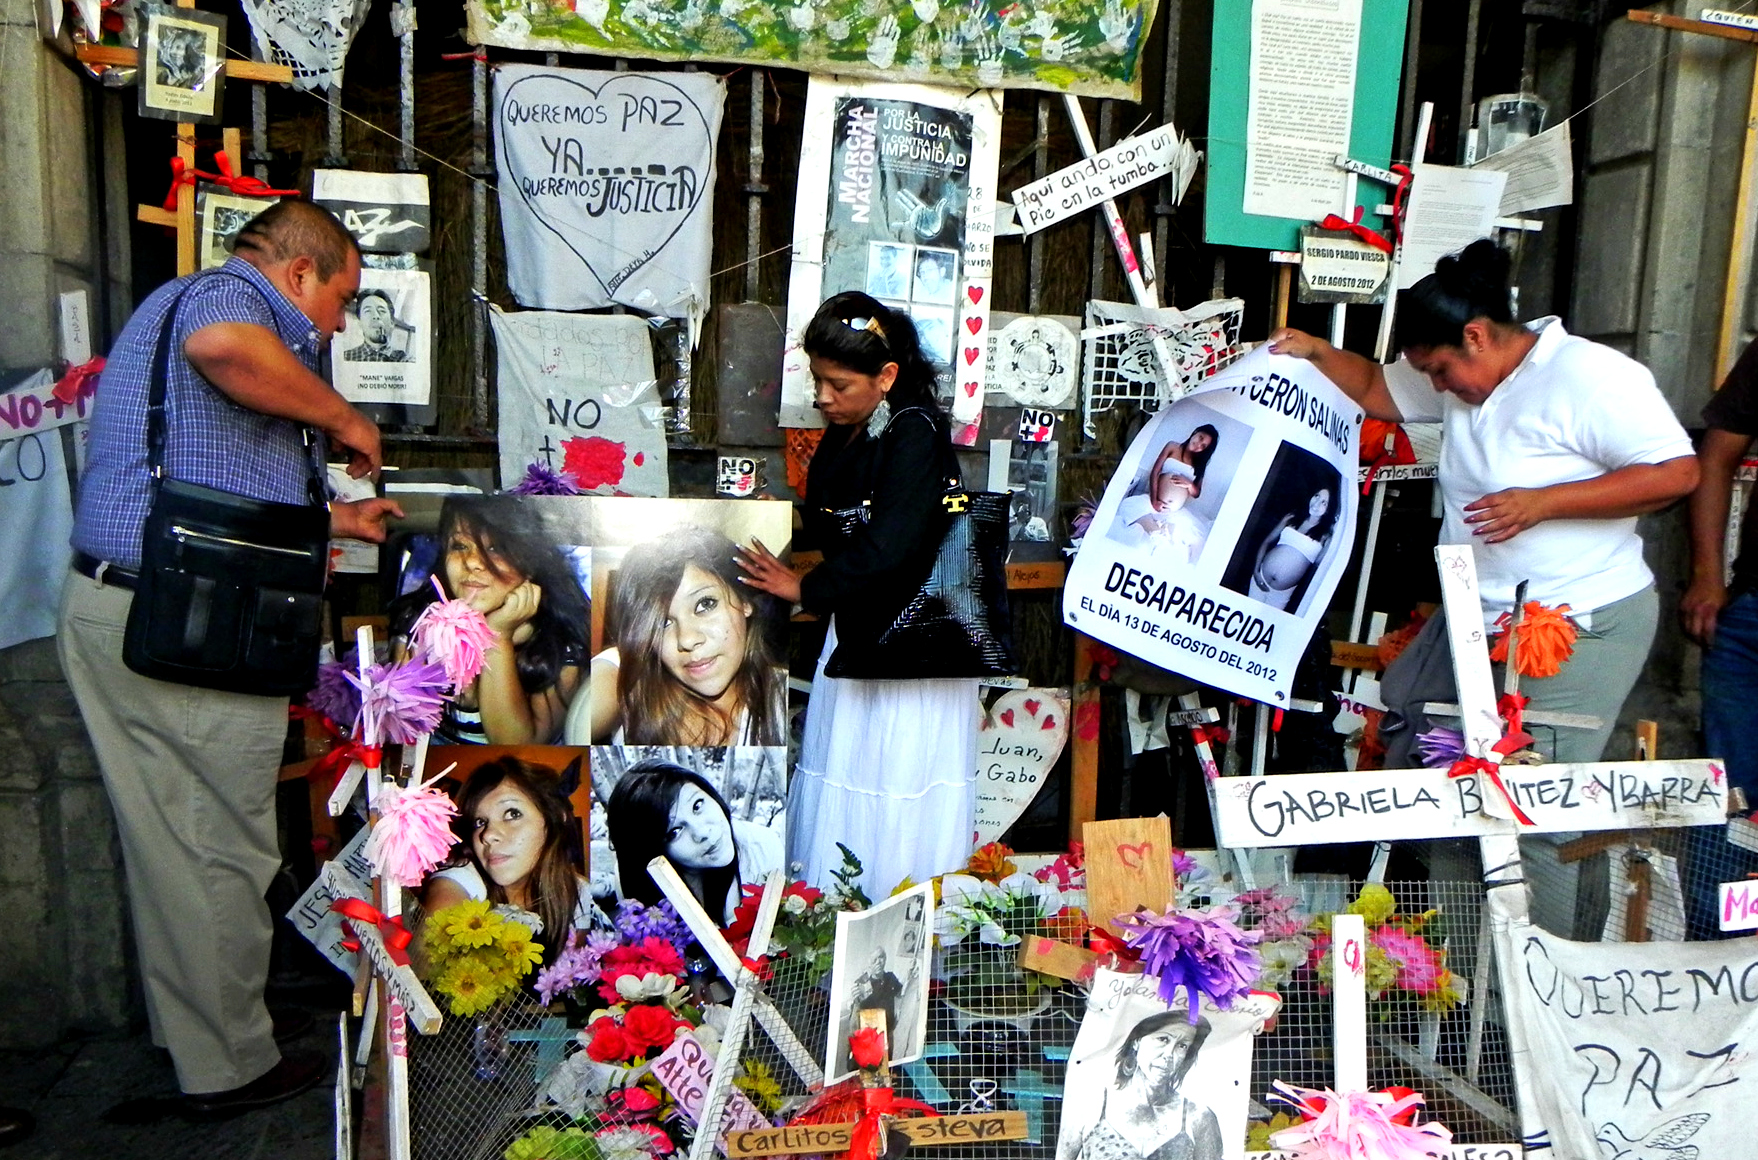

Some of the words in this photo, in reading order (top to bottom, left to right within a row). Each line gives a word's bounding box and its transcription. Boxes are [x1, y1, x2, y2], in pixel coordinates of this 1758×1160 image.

[508, 99, 608, 126] QUEREMOS
[617, 93, 685, 132] PAZ
[884, 108, 905, 118] POR
[907, 110, 920, 121] LA
[883, 117, 952, 140] JUSTICIA
[838, 105, 864, 204] MARCHA
[881, 142, 968, 167] IMPUNIDAD
[882, 133, 889, 143] Y
[890, 134, 931, 149] CONTRA
[932, 138, 945, 151] LA
[1117, 144, 1148, 165] con
[1151, 132, 1171, 151] un
[851, 107, 879, 224] NACIONAL
[1343, 159, 1392, 183] KARLITA
[522, 176, 601, 200] QUEREMOS
[586, 165, 698, 218] JUSTICIA
[1061, 194, 1083, 210] en
[1086, 185, 1105, 200] la
[979, 243, 990, 253] SE
[1306, 247, 1334, 259] SERGIO
[1335, 249, 1360, 261] PARDO
[1360, 252, 1386, 263] VIESCA
[1311, 275, 1317, 286] 2
[1317, 276, 1328, 286] DE
[1327, 276, 1356, 288] AGOSTO
[1356, 278, 1376, 289] 2012
[546, 397, 602, 430] NO
[1021, 408, 1054, 427] NO
[1308, 396, 1350, 456] SALINAS
[721, 459, 755, 476] NO
[1104, 561, 1275, 654] DESAPARECIDA
[1080, 596, 1096, 614] EL
[1124, 614, 1140, 630] 13
[1141, 620, 1161, 638] DE
[1160, 629, 1217, 659] AGOSTO
[1218, 650, 1243, 671] DEL
[1245, 660, 1278, 682] 2012
[987, 763, 1037, 784] Gabo
[1248, 780, 1440, 838] GABRIELA
[1455, 777, 1581, 819] BITEZ
[1592, 769, 1722, 813] YBARRA
[1573, 1042, 1740, 1118] PAZ
[736, 1128, 849, 1153] Carlitos
